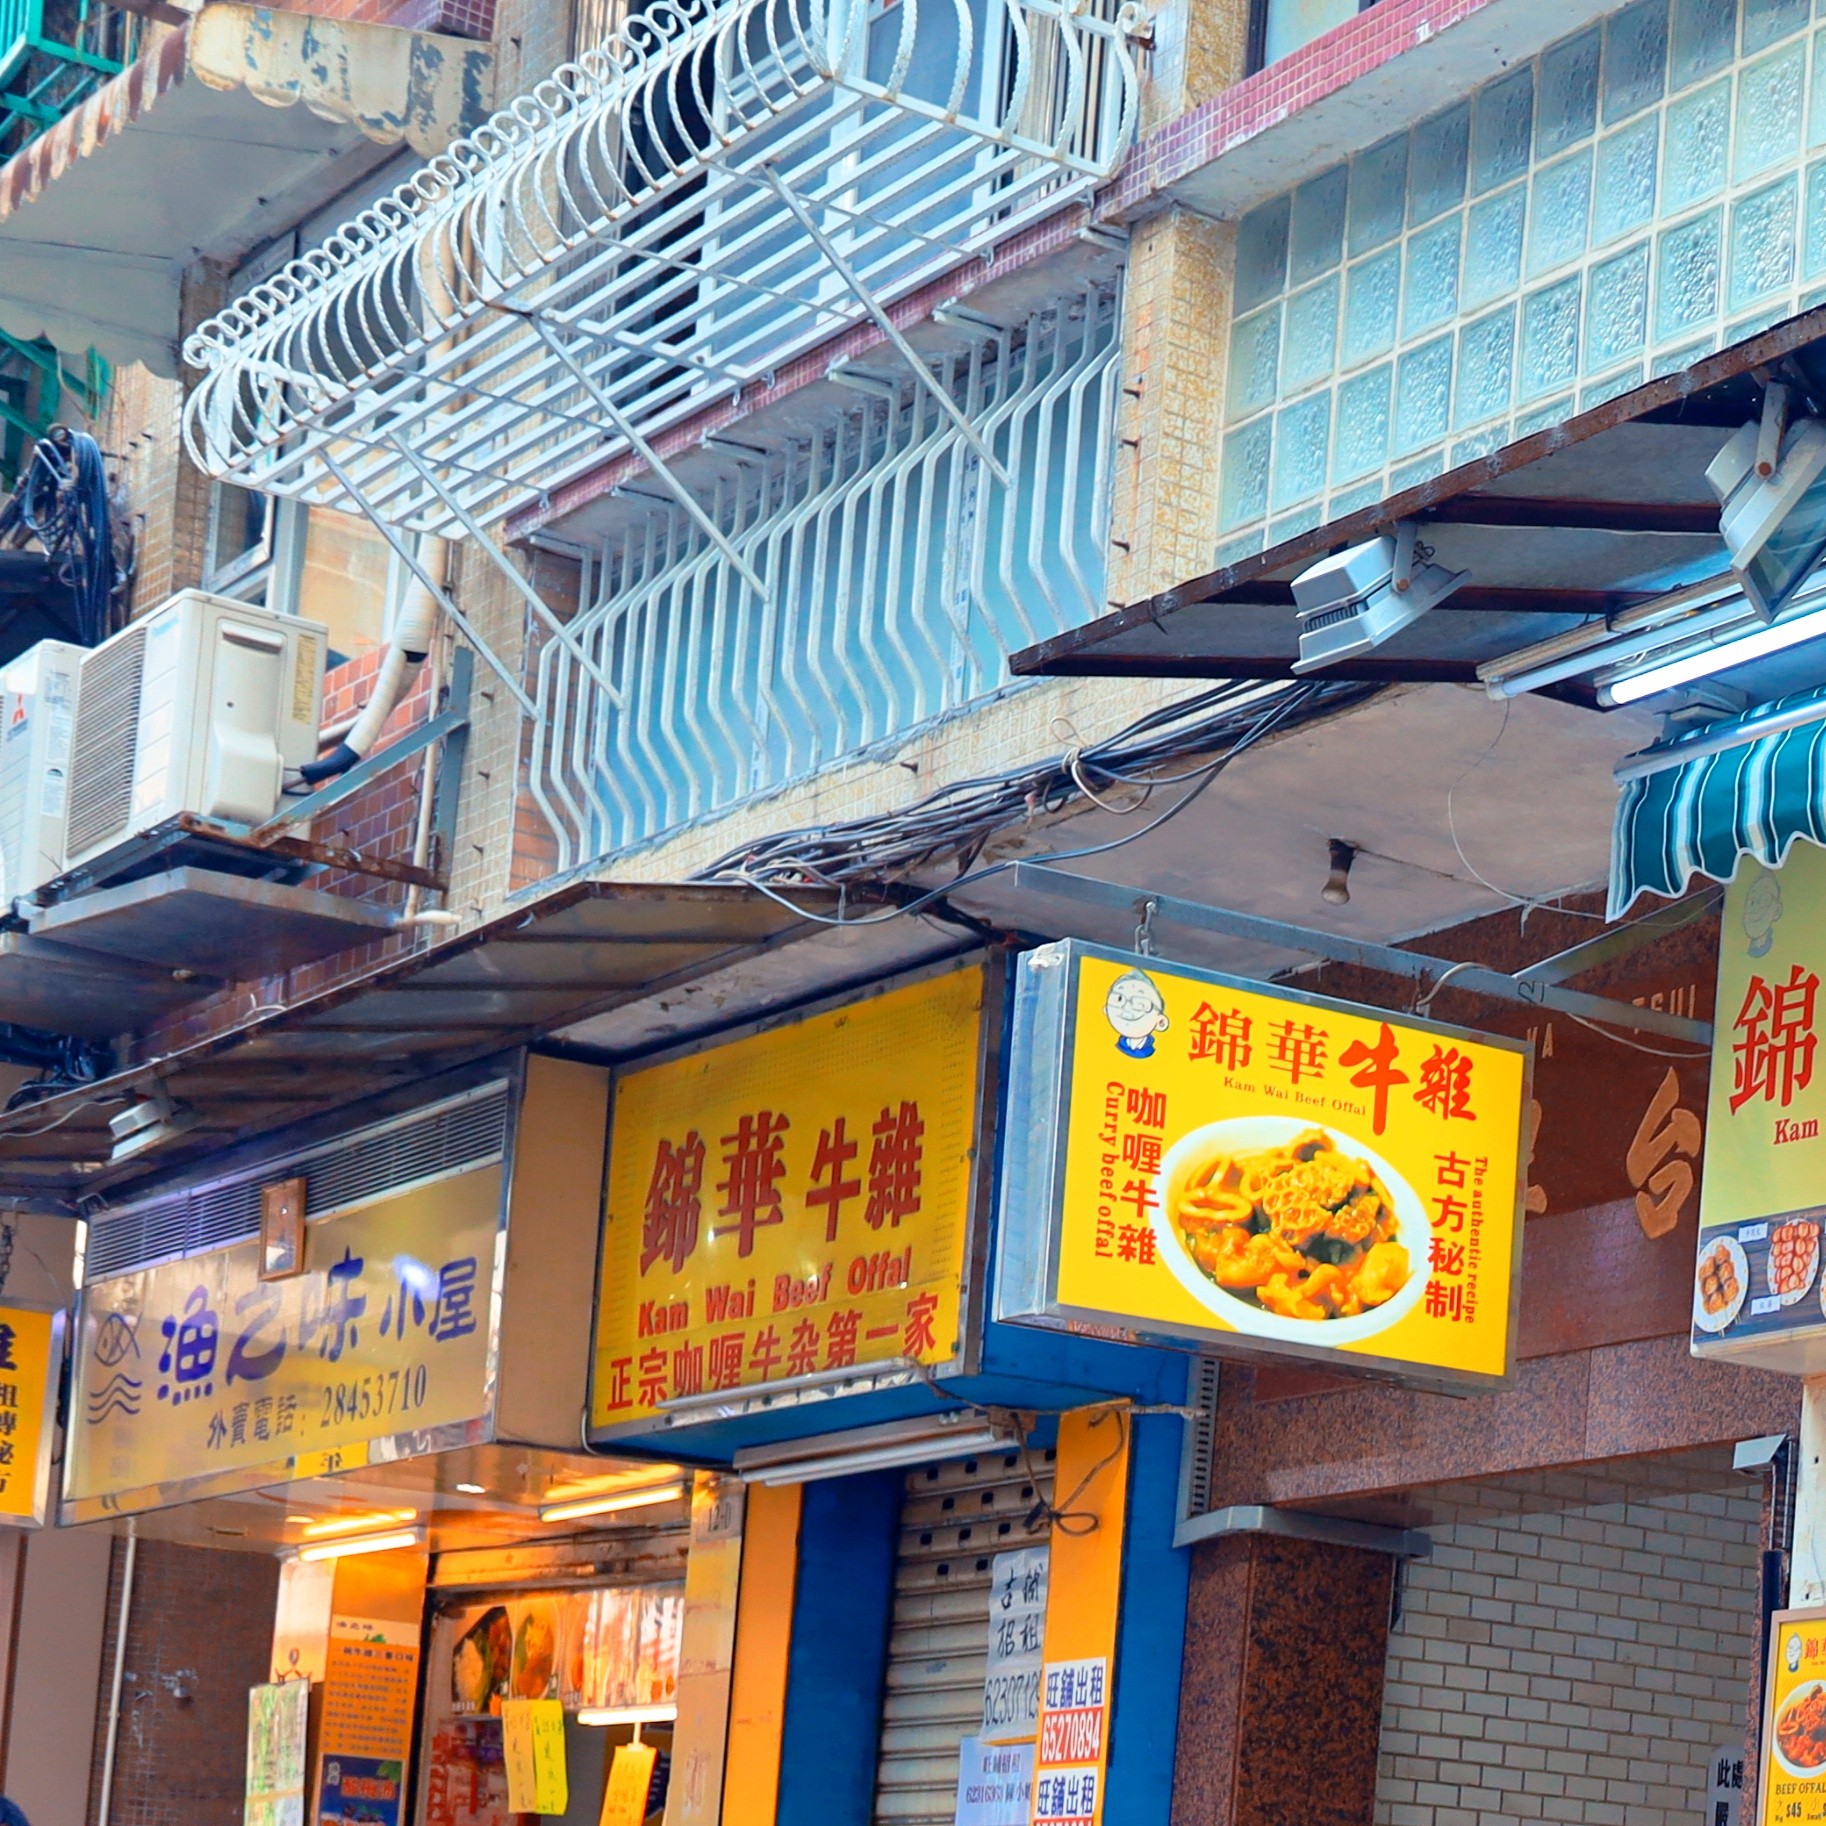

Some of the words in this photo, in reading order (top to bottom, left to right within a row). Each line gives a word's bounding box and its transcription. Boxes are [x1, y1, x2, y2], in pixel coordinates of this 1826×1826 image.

[1187, 1003, 1476, 1134] 錦華牛雜
[1104, 1081, 1125, 1147] Curry
[1224, 1077, 1256, 1093] Kam
[1264, 1085, 1289, 1100] Wai
[1295, 1091, 1326, 1109] Beef
[1332, 1099, 1366, 1116] Offal
[1773, 1117, 1819, 1145] Kam
[640, 1100, 925, 1276] 錦華牛雜
[1100, 1153, 1117, 1206] beef
[1117, 1087, 1167, 1266] 咖喱牛雜
[1473, 1157, 1488, 1183] The
[1095, 1207, 1113, 1259] offal
[1425, 1151, 1470, 1322] 古方秘制
[1468, 1190, 1484, 1269] authentic
[638, 1299, 688, 1338] Kam
[706, 1279, 755, 1323] Wai
[773, 1262, 830, 1312] Beef
[847, 1246, 912, 1297] Offal
[1463, 1273, 1478, 1325] recipe
[320, 1369, 428, 1428] 28453710
[1042, 1711, 1101, 1761] 65270894
[1775, 1783, 1797, 1795] BEEF
[1799, 1781, 1826, 1794] OFFAL
[1786, 1802, 1801, 1818] $45
